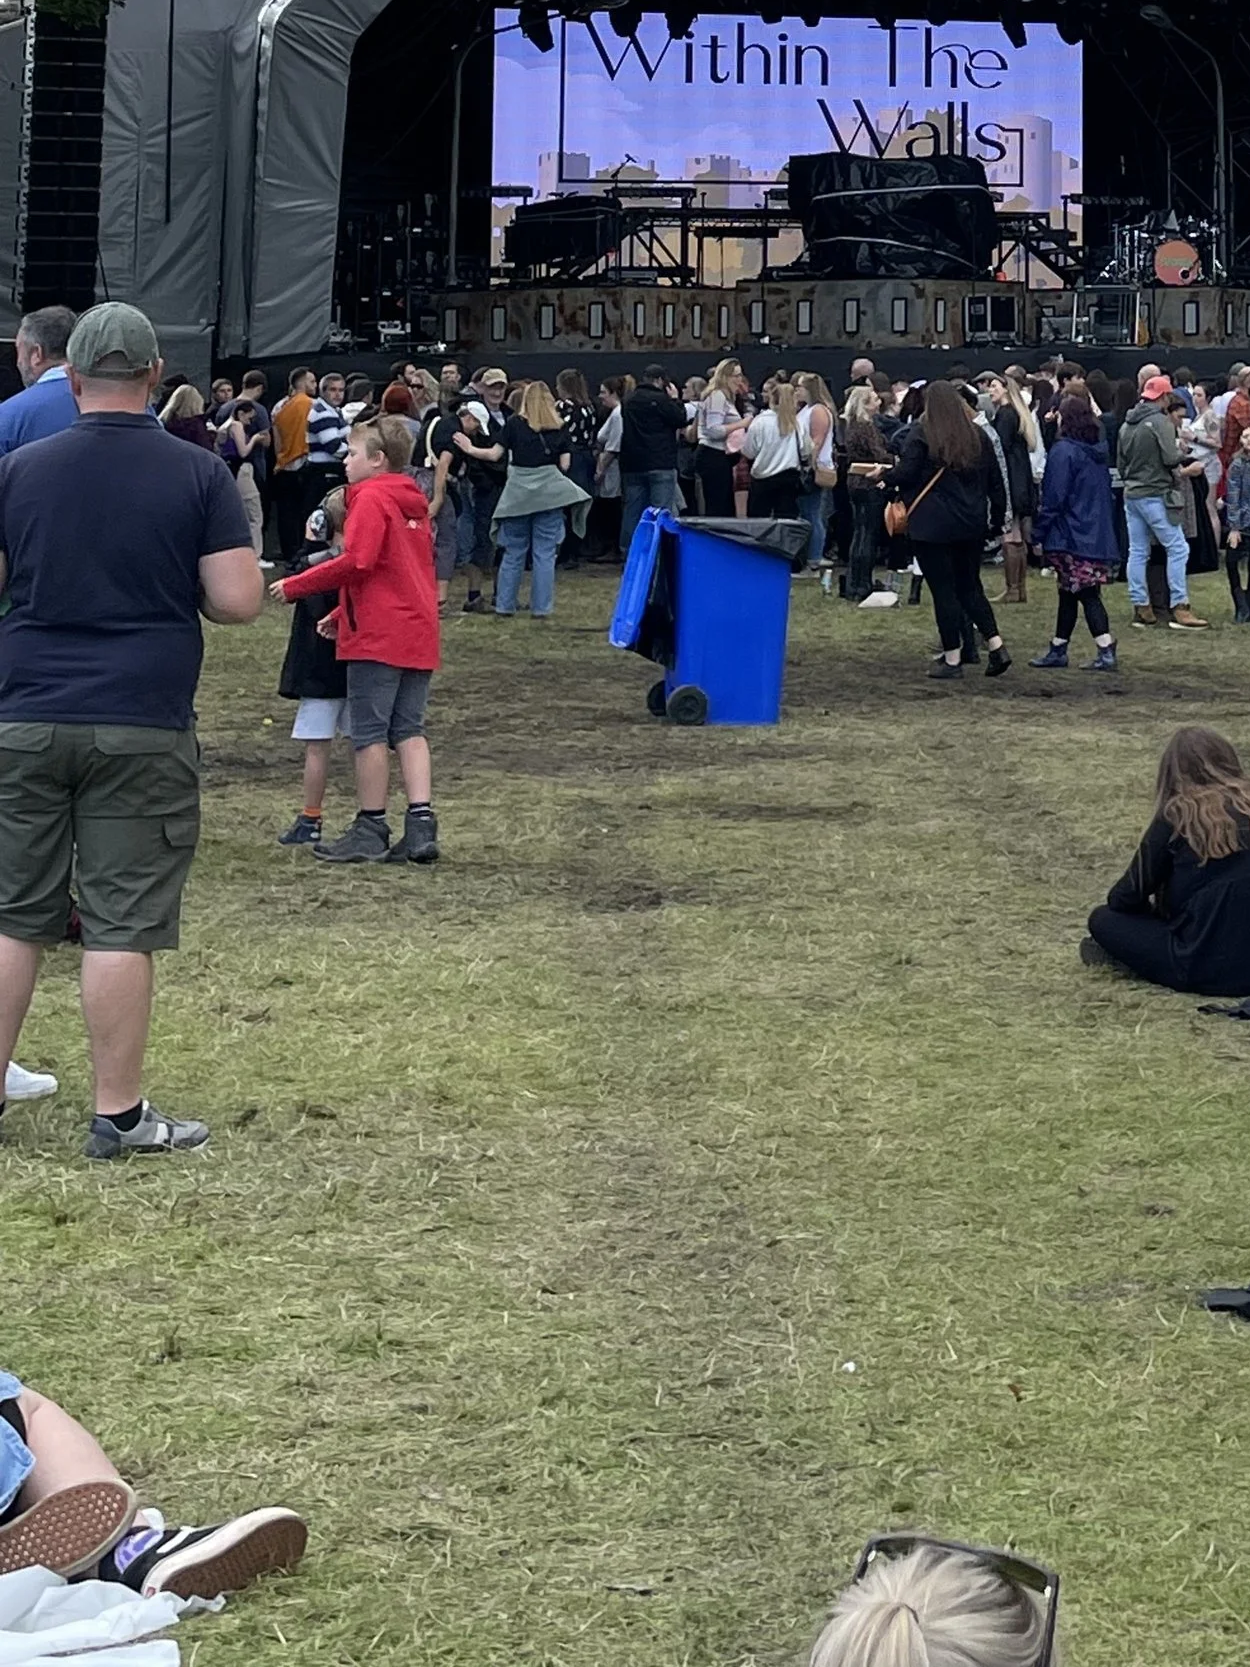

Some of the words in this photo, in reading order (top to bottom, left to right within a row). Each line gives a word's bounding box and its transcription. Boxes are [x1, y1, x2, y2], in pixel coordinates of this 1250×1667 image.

[583, 21, 829, 86] Within
[867, 26, 1009, 89] The
[816, 98, 1007, 162] Walls
